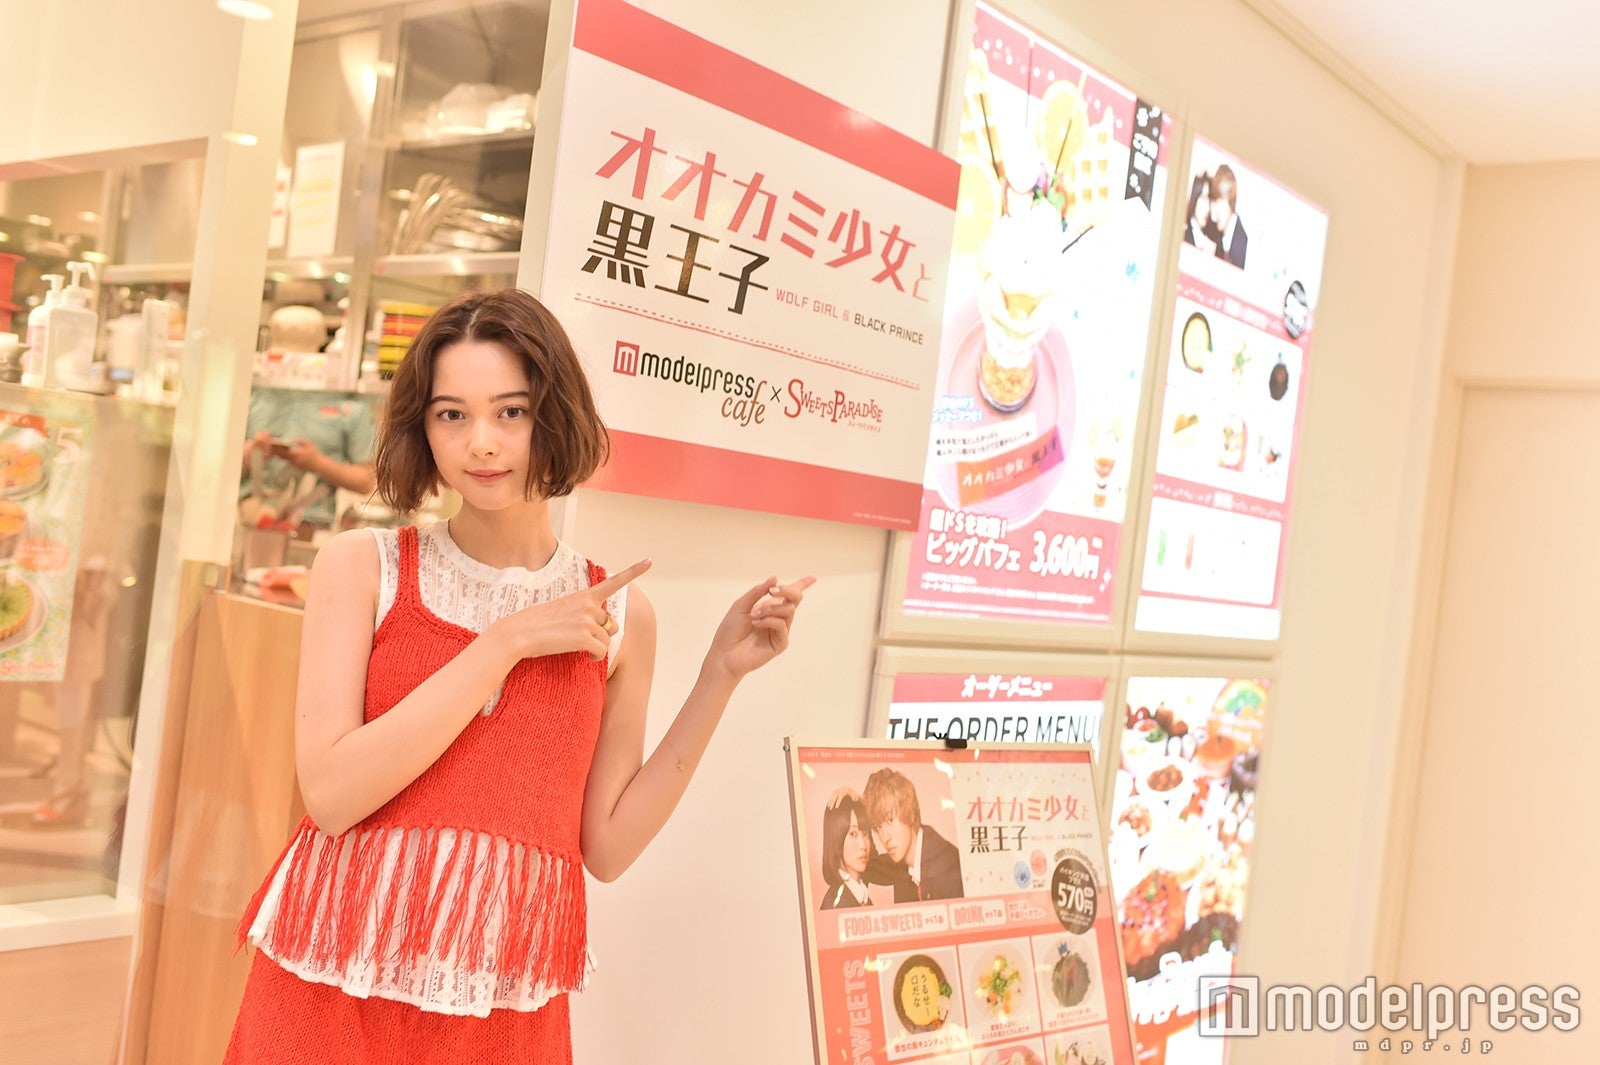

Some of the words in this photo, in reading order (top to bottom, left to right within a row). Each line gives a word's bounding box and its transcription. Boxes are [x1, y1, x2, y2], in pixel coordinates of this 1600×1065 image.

[594, 126, 933, 303] オオカミ少女と
[580, 200, 770, 315] 黒王子
[776, 288, 809, 308] WOLF
[813, 300, 838, 318] GIRL
[842, 309, 850, 322] &
[854, 313, 886, 333] BLACK
[889, 324, 925, 345] PRINCE
[640, 351, 756, 399] modelpress
[721, 380, 767, 427] cafe
[926, 531, 1021, 571] ビッグパフェ
[961, 674, 1053, 698] オーダーメニュー
[889, 718, 939, 739] THE
[947, 717, 1028, 742] ORDER
[1036, 715, 1096, 743] MENU
[970, 826, 1029, 853] 黒王子
[844, 915, 873, 937] FOOD
[881, 912, 923, 933] SWEETS
[954, 905, 984, 926] DRINK
